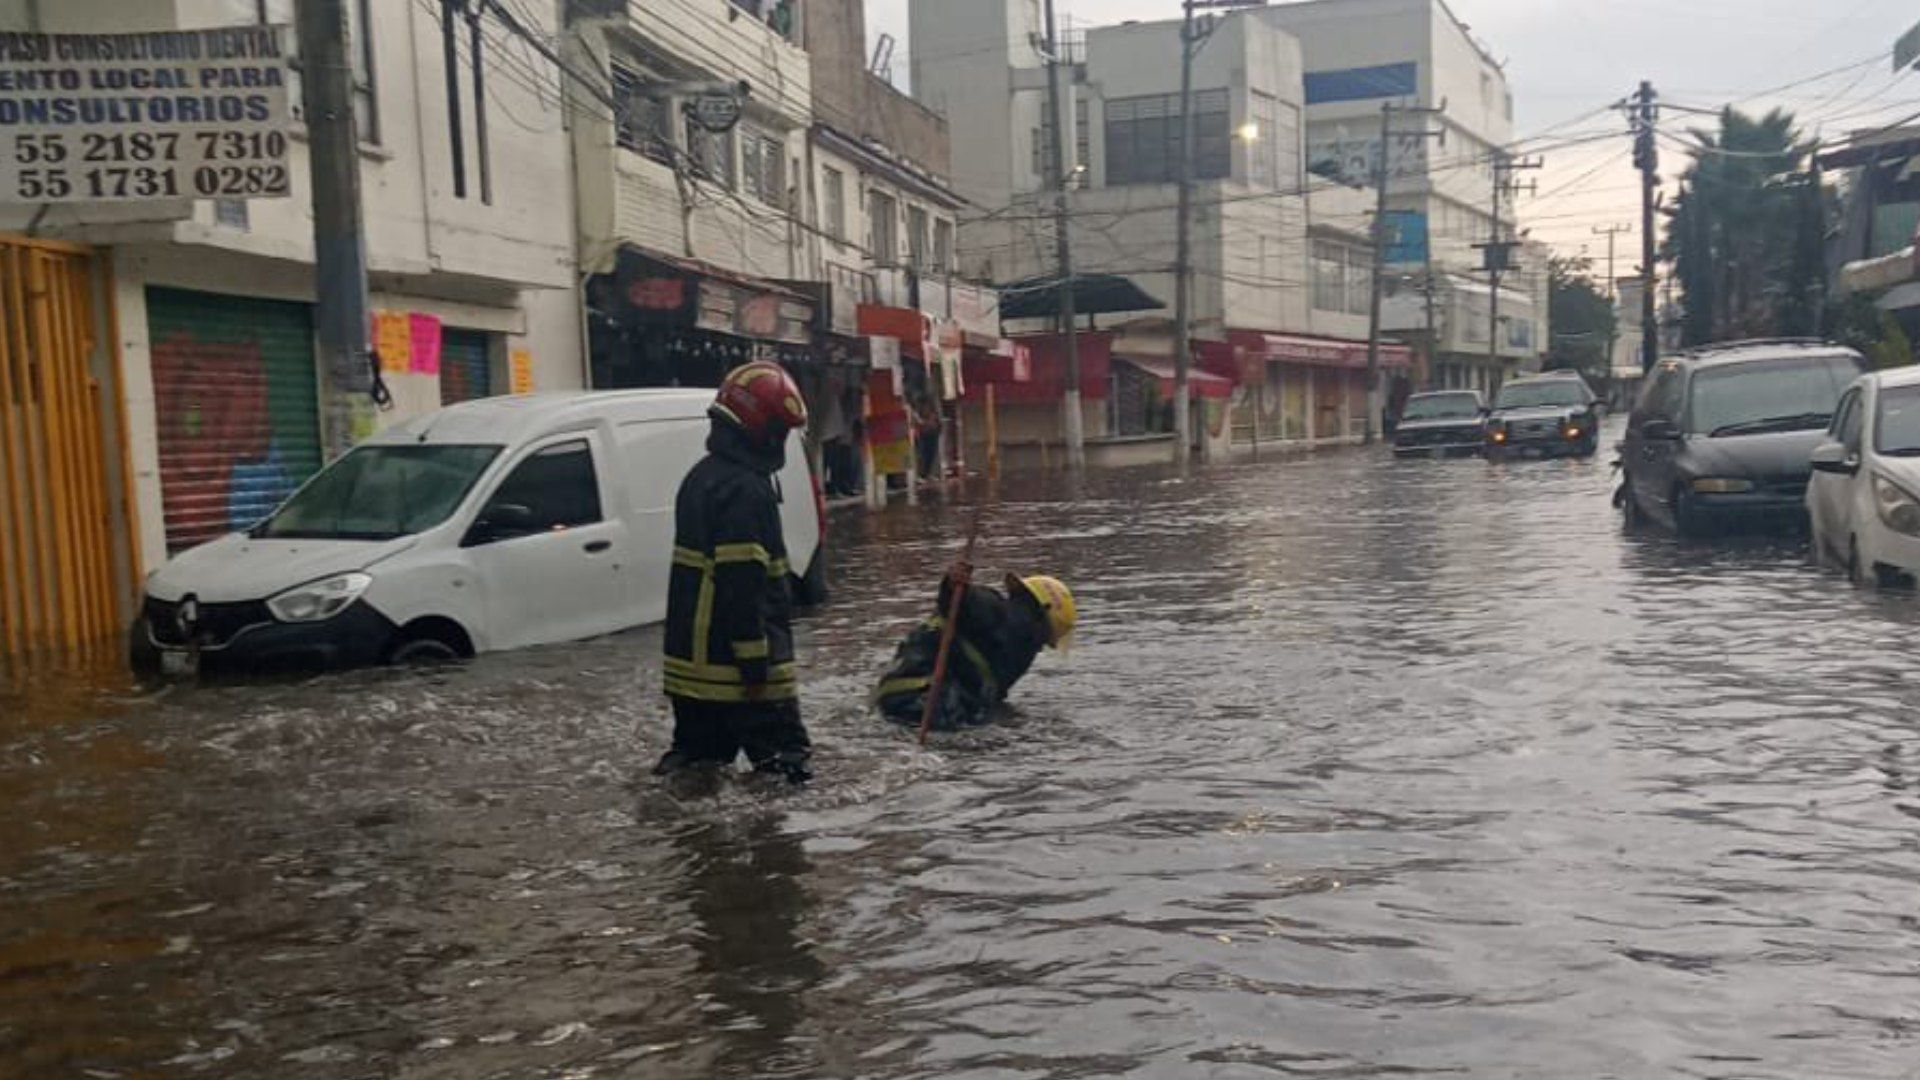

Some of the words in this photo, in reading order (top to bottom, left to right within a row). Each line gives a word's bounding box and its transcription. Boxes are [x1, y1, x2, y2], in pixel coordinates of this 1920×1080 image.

[55, 31, 200, 61] CONSULTORIO
[206, 27, 281, 59] DENTAL
[89, 68, 192, 90] LOCAL
[200, 66, 283, 88] PARA
[14, 134, 67, 163] 55
[81, 132, 180, 161] 2187
[195, 131, 286, 160] 7310
[18, 170, 71, 197] 55
[85, 167, 179, 196] 1731
[195, 166, 286, 195] 0282
